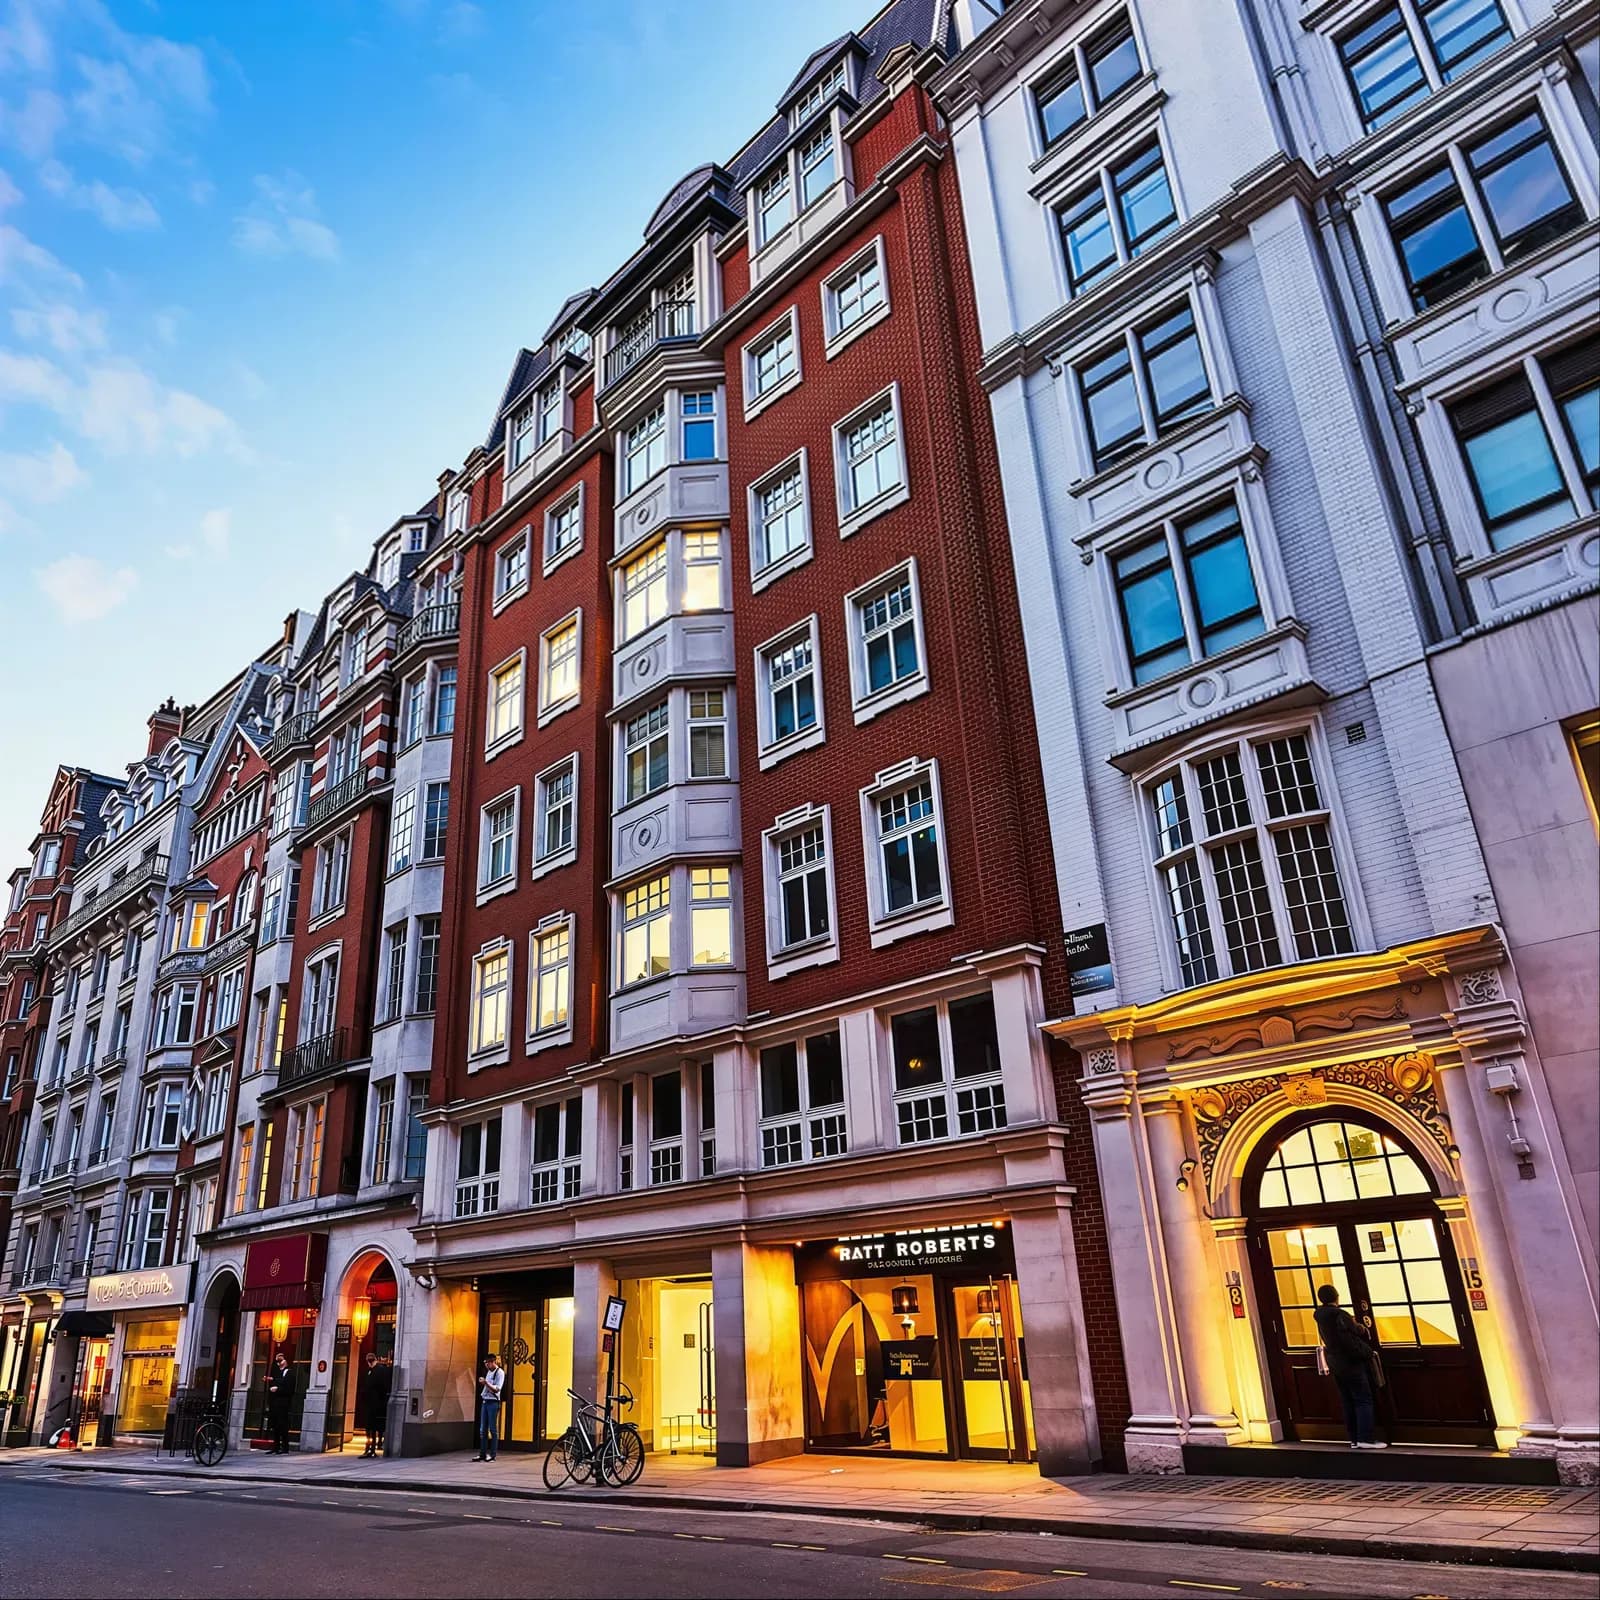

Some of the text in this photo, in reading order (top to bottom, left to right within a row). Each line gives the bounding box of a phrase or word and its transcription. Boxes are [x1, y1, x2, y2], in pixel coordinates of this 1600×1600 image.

[839, 1235, 995, 1261] RATT ROBERTS
[1463, 1269, 1483, 1289] 15
